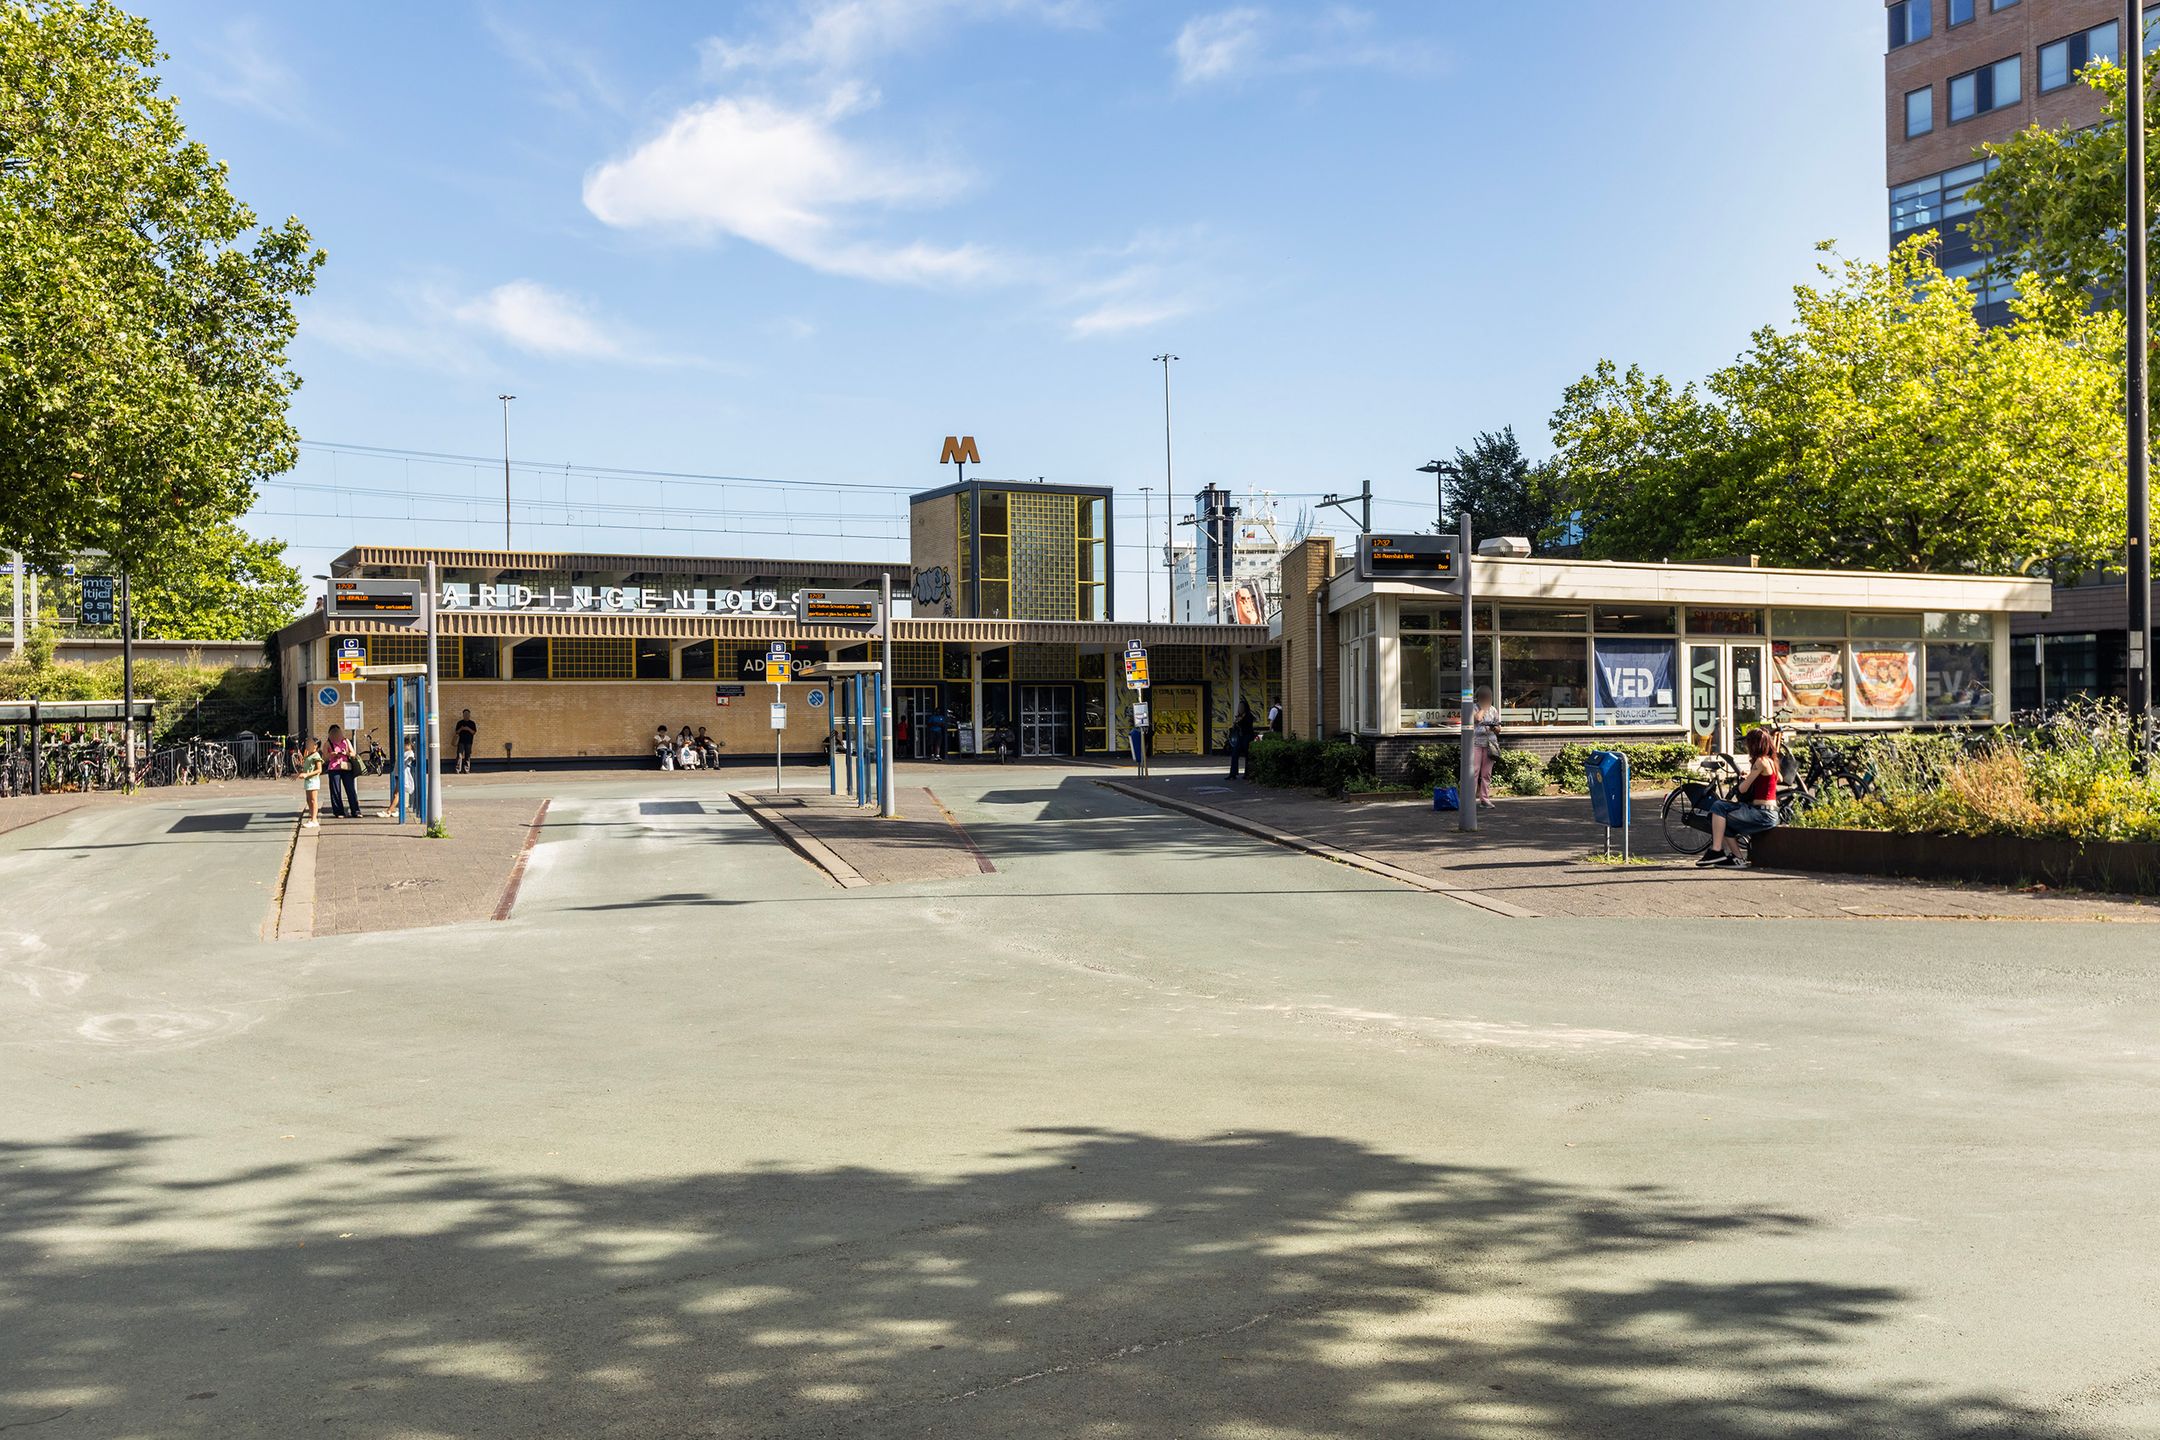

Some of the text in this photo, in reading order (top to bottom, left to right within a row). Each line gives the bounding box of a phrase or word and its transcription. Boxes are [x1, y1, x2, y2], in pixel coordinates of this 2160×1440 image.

[940, 436, 981, 464] M
[441, 585, 799, 612] ARDINGEN OOS
[1605, 667, 1654, 698] VED
[1693, 659, 1716, 737] VED
[1426, 711, 1440, 720] 010
[1532, 708, 1558, 722] VED
[1615, 709, 1657, 719] SNACKBAR
